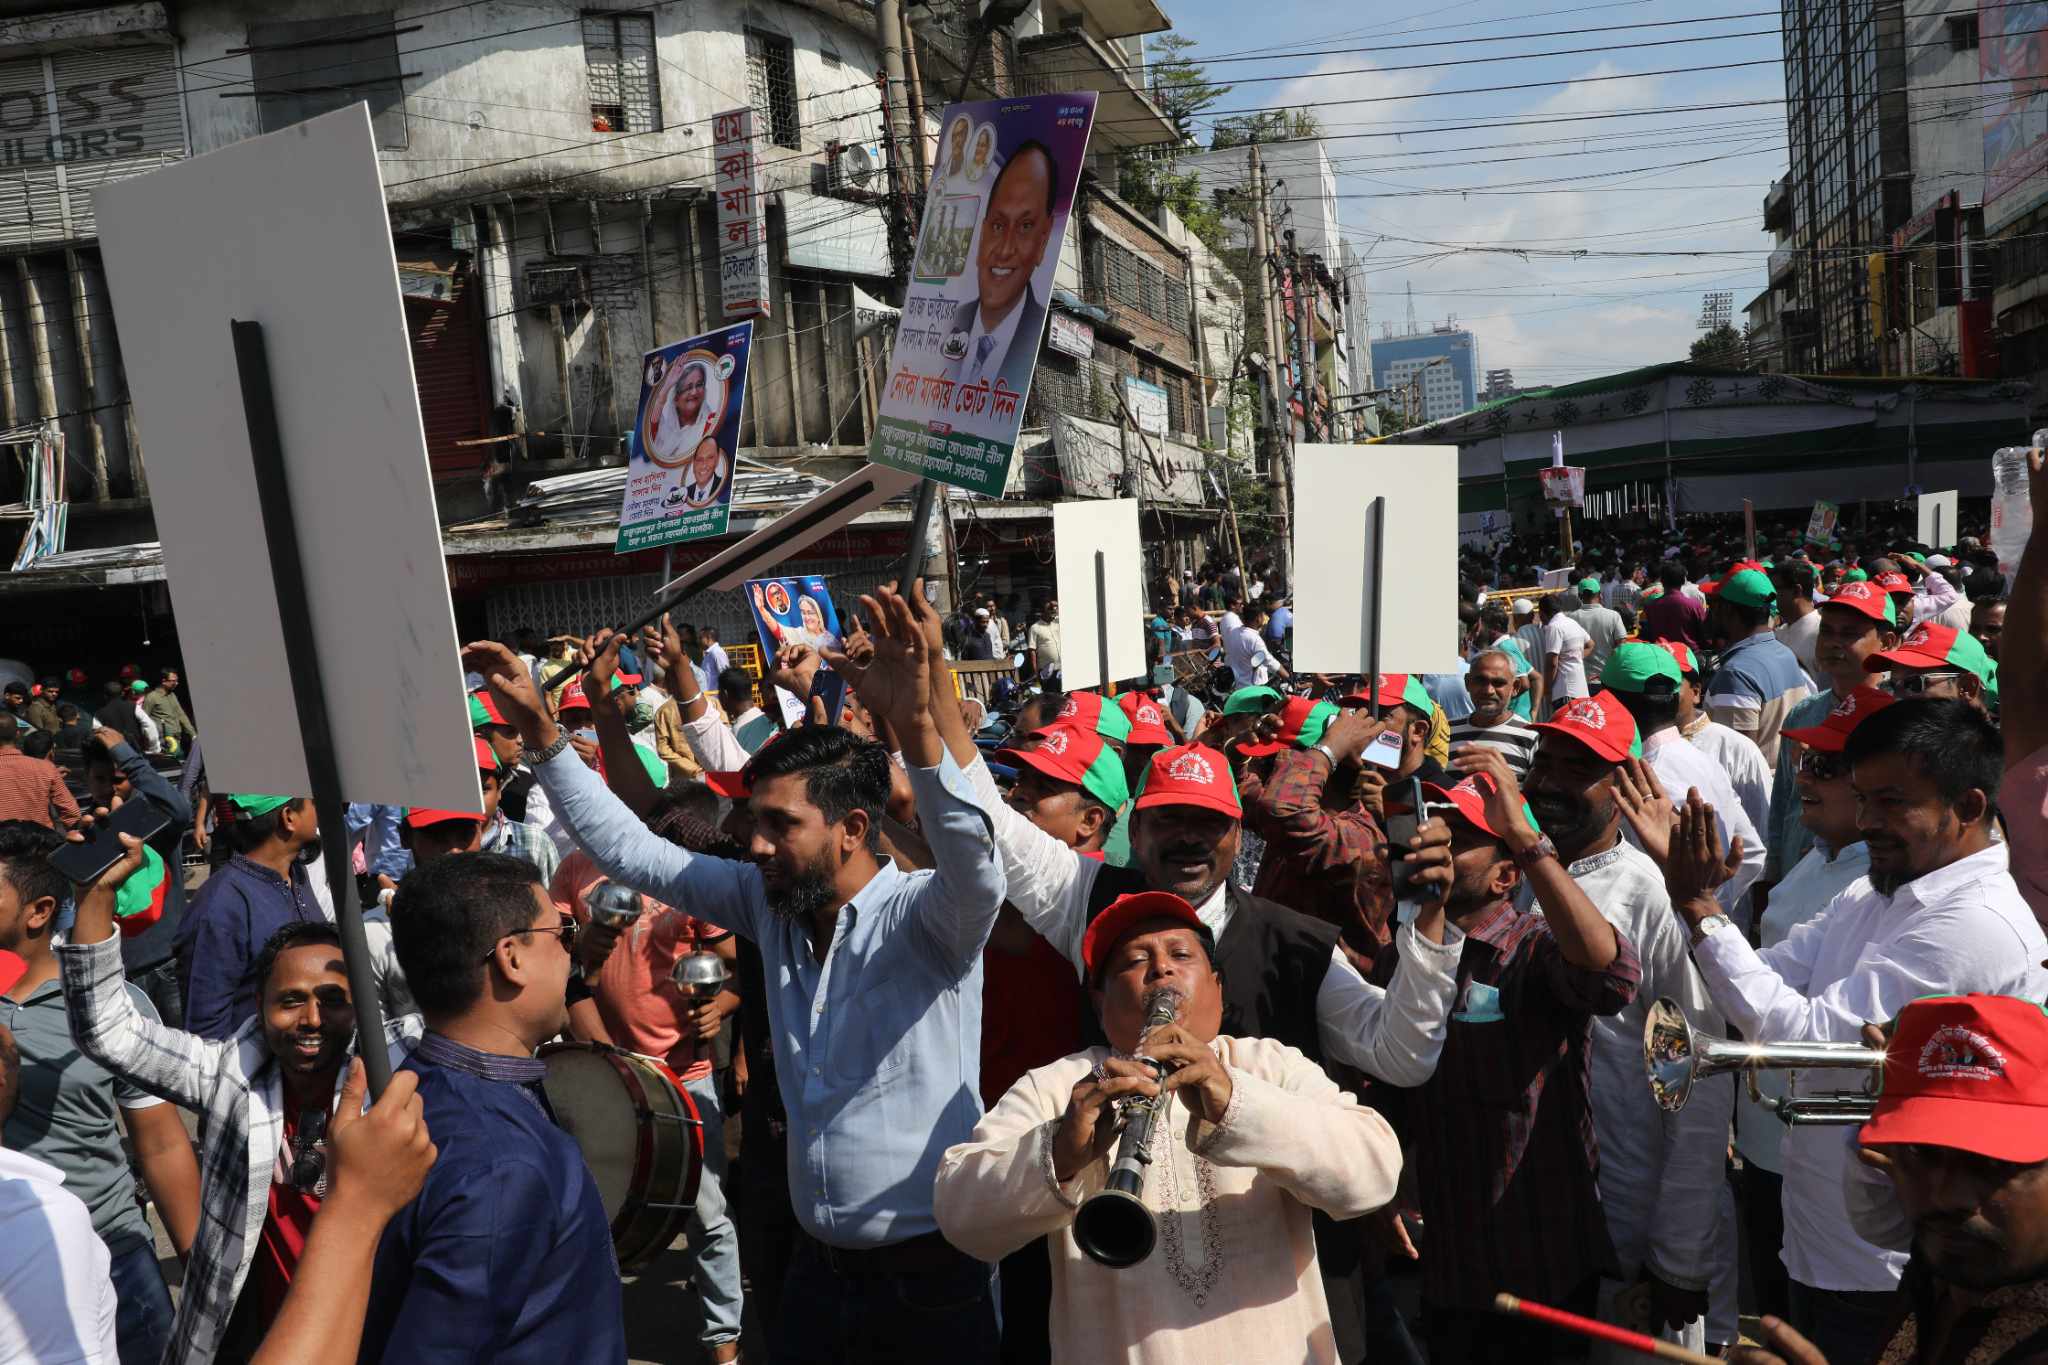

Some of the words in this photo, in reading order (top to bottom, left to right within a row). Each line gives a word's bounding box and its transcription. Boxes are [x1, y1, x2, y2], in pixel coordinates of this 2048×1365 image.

[901, 326, 926, 350] সালাম
[926, 323, 942, 350] দিন
[890, 364, 920, 403] নৌকা
[920, 368, 956, 412] মার্কায়
[955, 376, 990, 416] ভোট
[989, 377, 1021, 424] দিন
[985, 444, 1006, 466] লীগ
